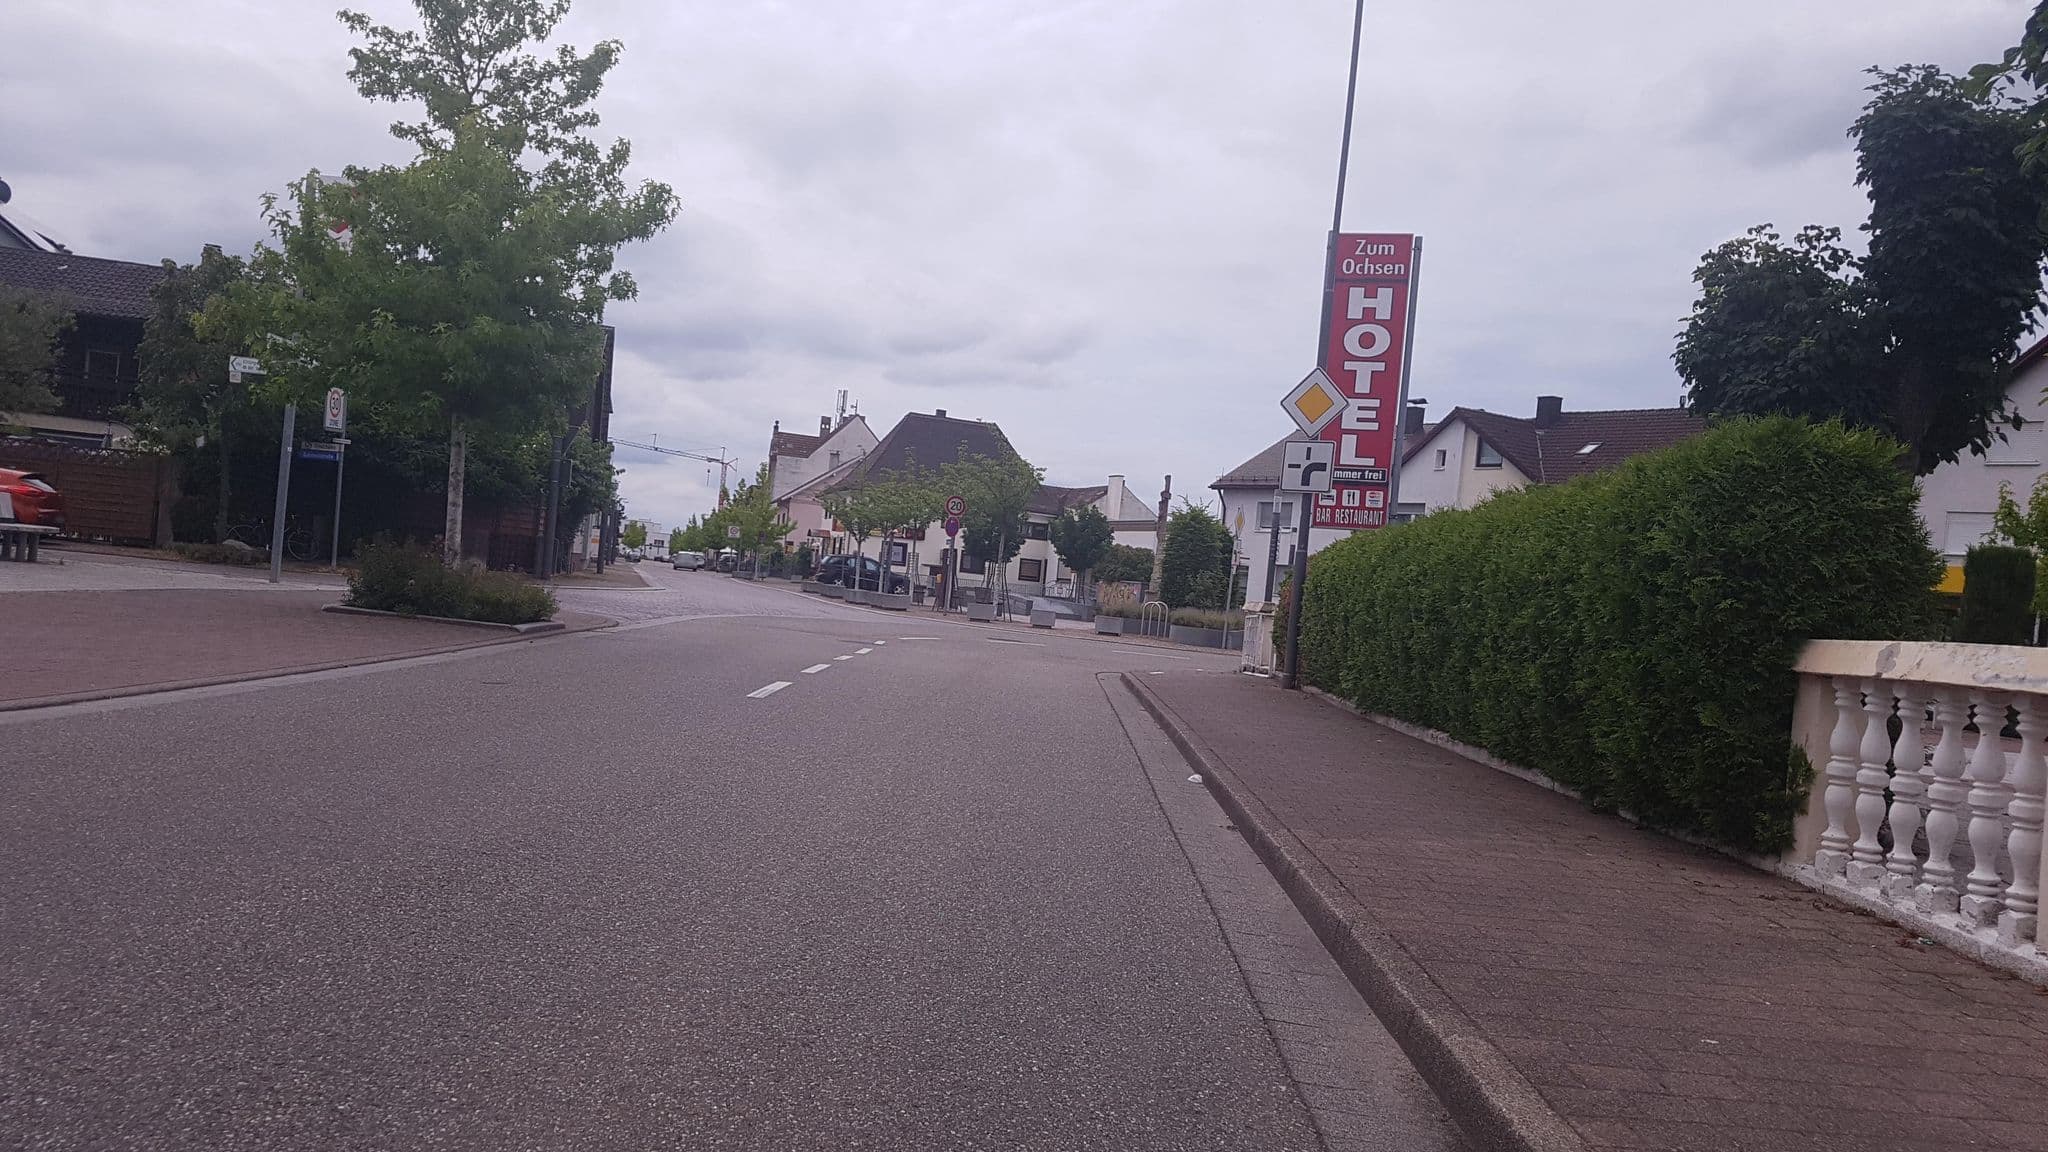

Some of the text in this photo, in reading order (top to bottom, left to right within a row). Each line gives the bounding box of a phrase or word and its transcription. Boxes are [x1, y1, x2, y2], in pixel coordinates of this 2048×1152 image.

[1355, 239, 1395, 255] Zum
[1342, 257, 1405, 275] Ochsen
[1340, 286, 1394, 466] HOTEL
[1334, 470, 1383, 480] mmer frei
[950, 500, 962, 511] 20
[1316, 507, 1385, 526] BAR RESTAURANT
